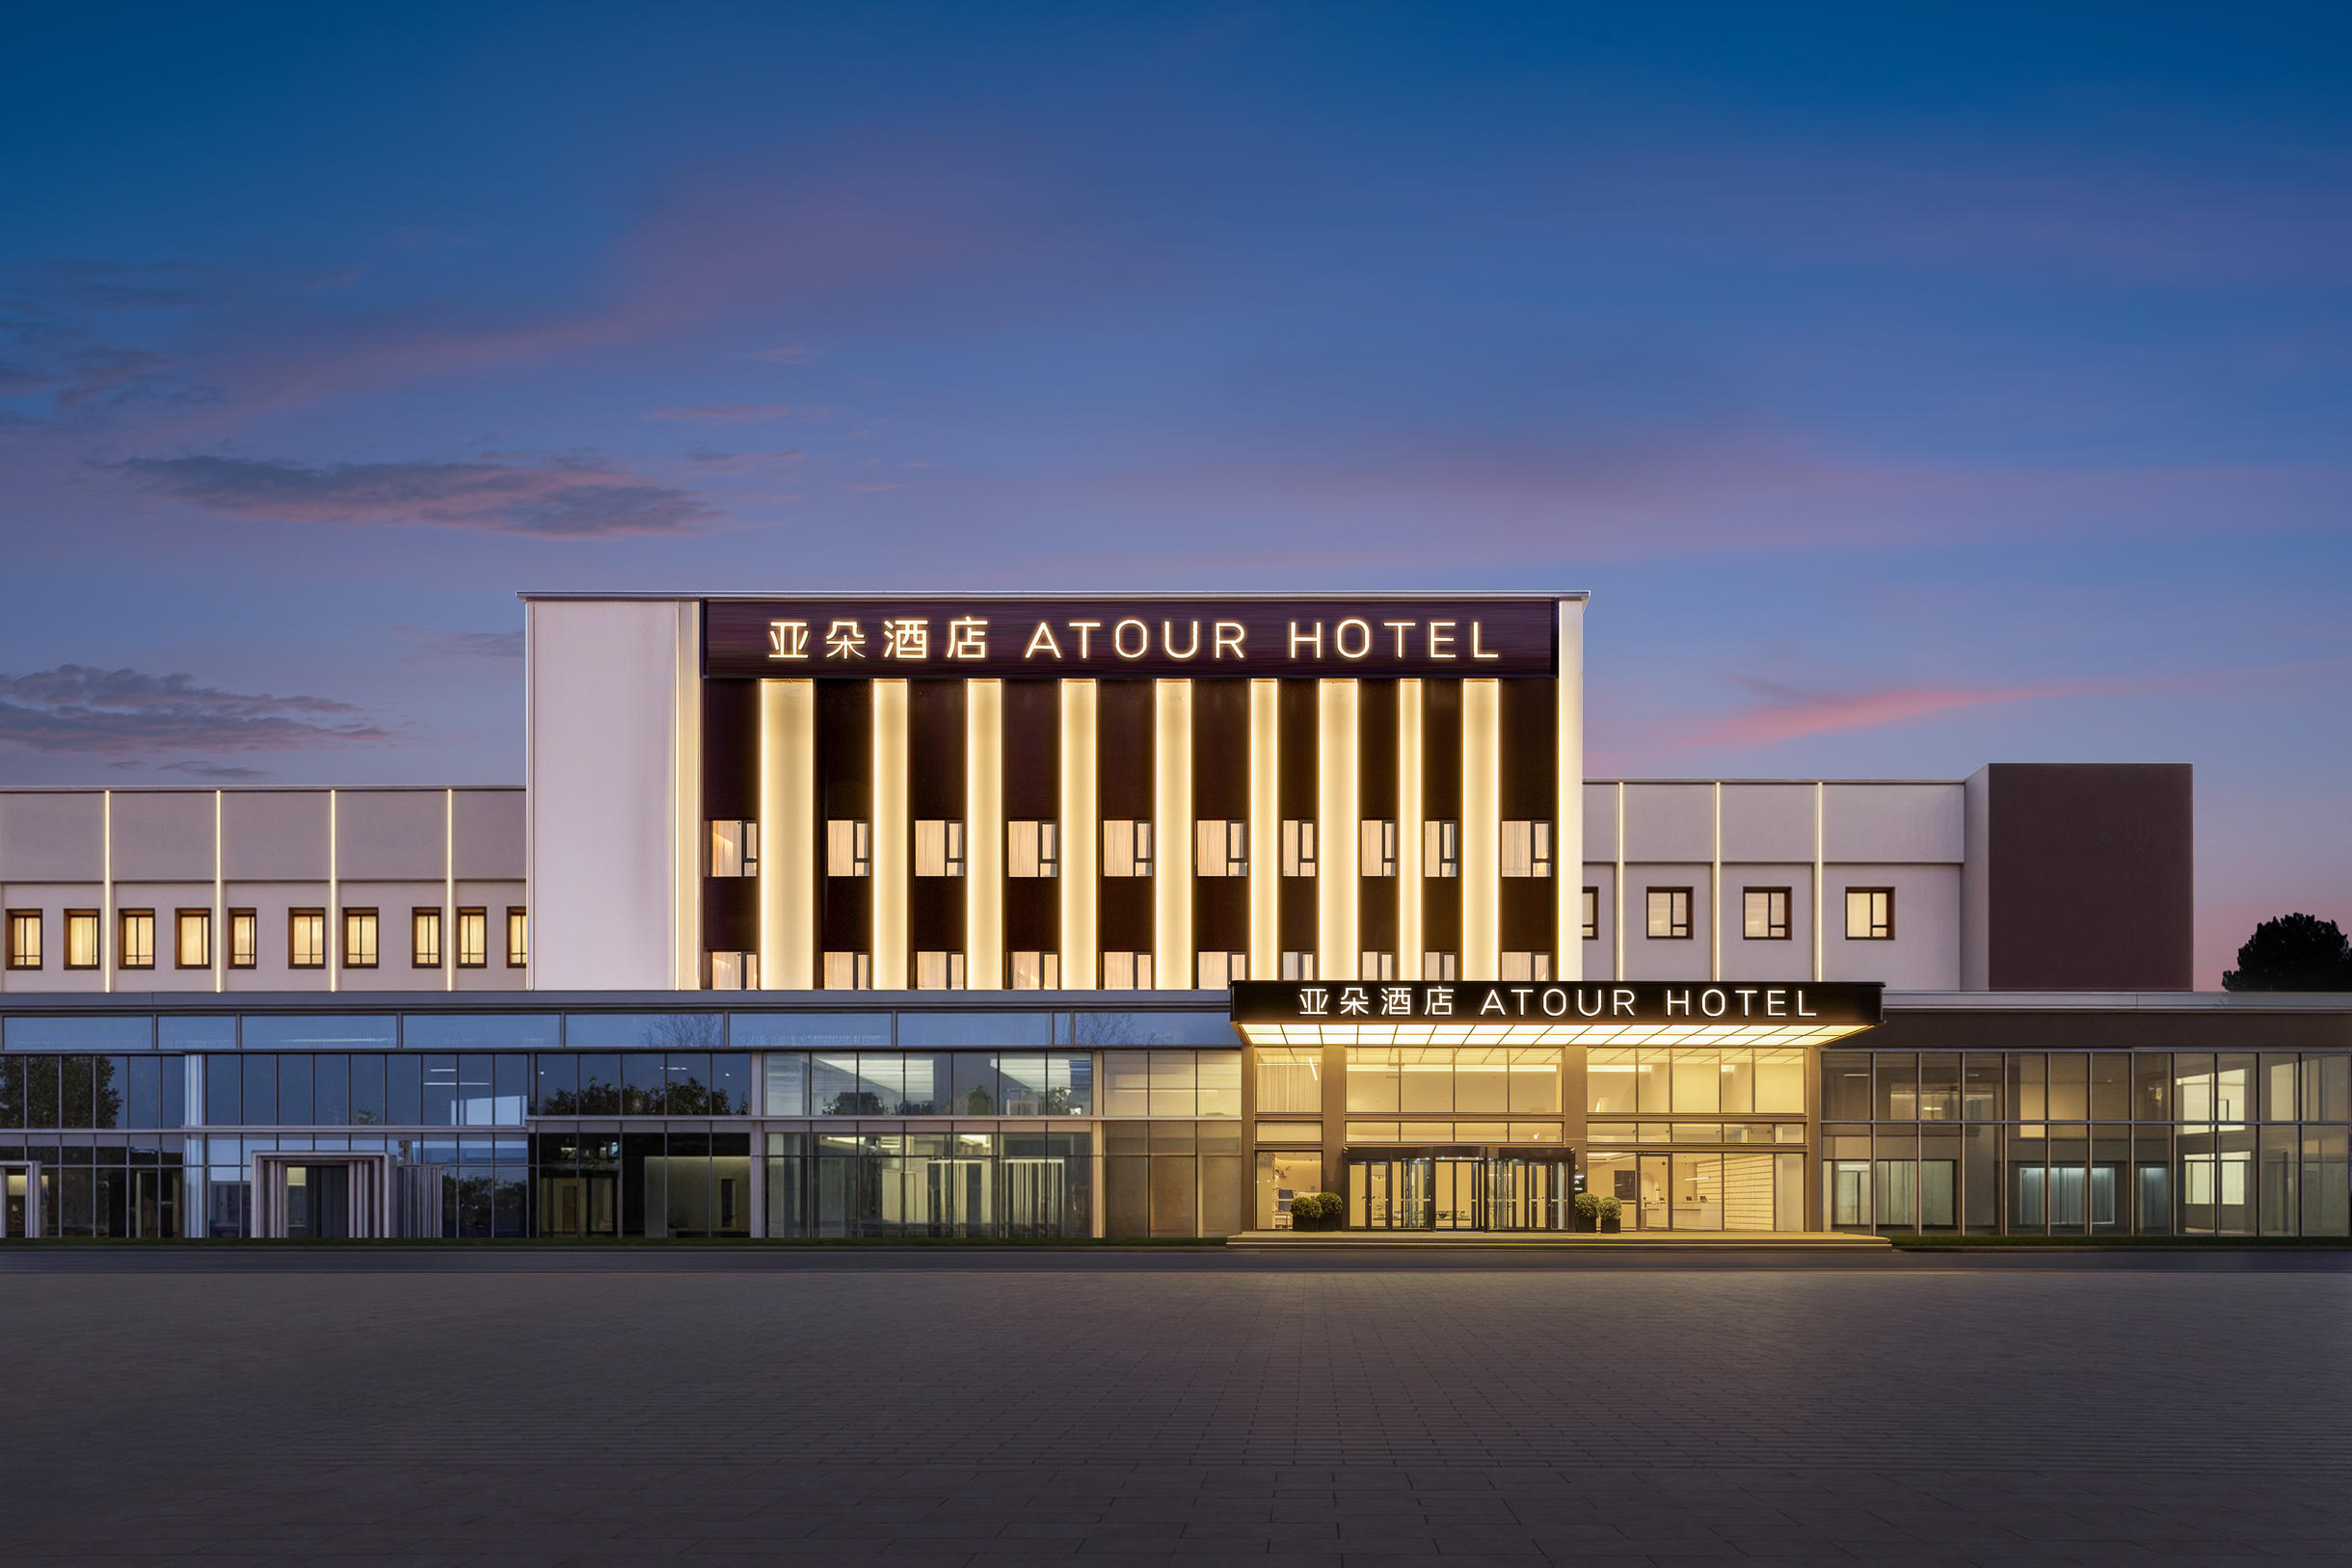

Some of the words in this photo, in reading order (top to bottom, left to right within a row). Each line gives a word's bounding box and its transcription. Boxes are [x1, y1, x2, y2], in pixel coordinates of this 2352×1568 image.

[767, 616, 988, 659] 亚朵酒店
[1024, 620, 1246, 659] ATOUR
[1289, 620, 1499, 659] HOTEL
[1298, 986, 1455, 1016] 亚朵酒店
[1480, 989, 1636, 1017] ATOUR
[1667, 989, 1818, 1017] HOTEL
